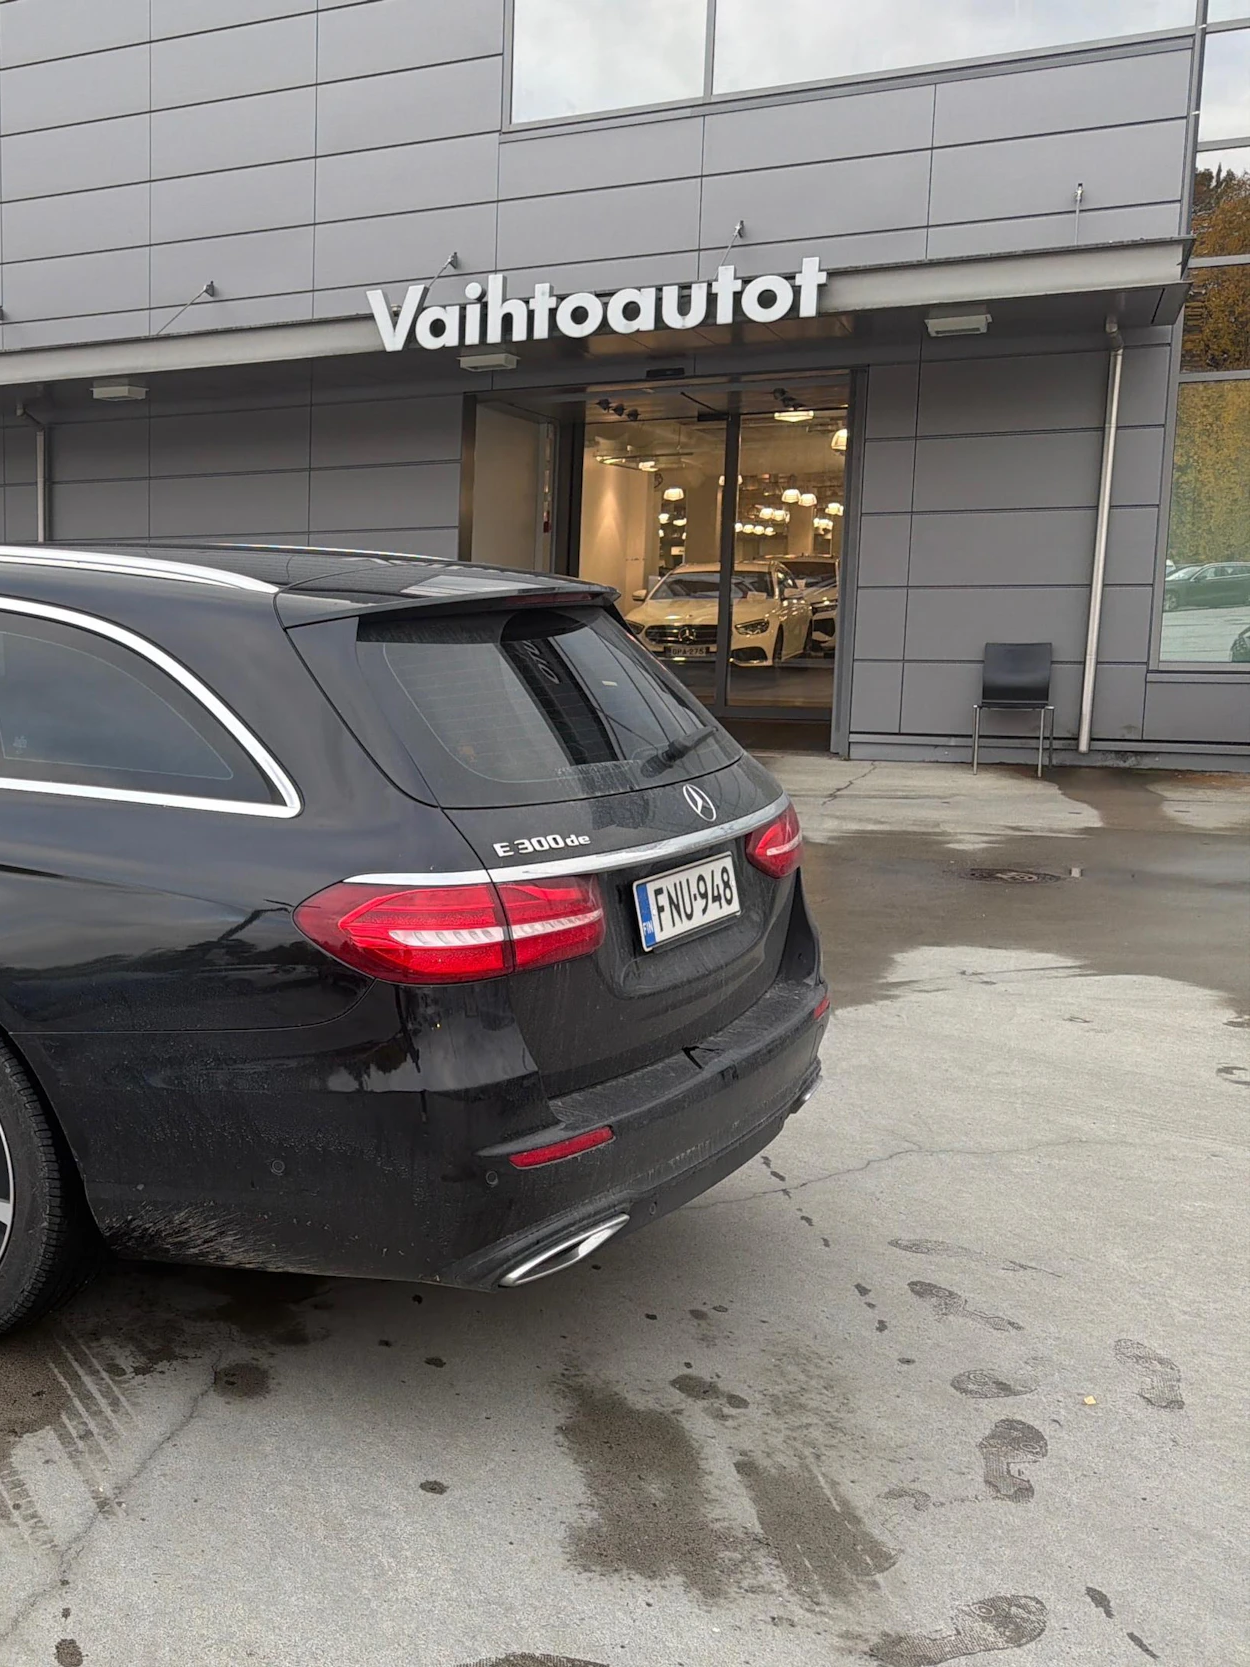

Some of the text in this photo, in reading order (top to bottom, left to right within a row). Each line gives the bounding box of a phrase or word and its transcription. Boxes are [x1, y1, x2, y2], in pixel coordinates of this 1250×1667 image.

[366, 257, 828, 352] Vaihtoautot
[493, 834, 591, 857] E 300 de
[653, 866, 733, 933] FNU-948
